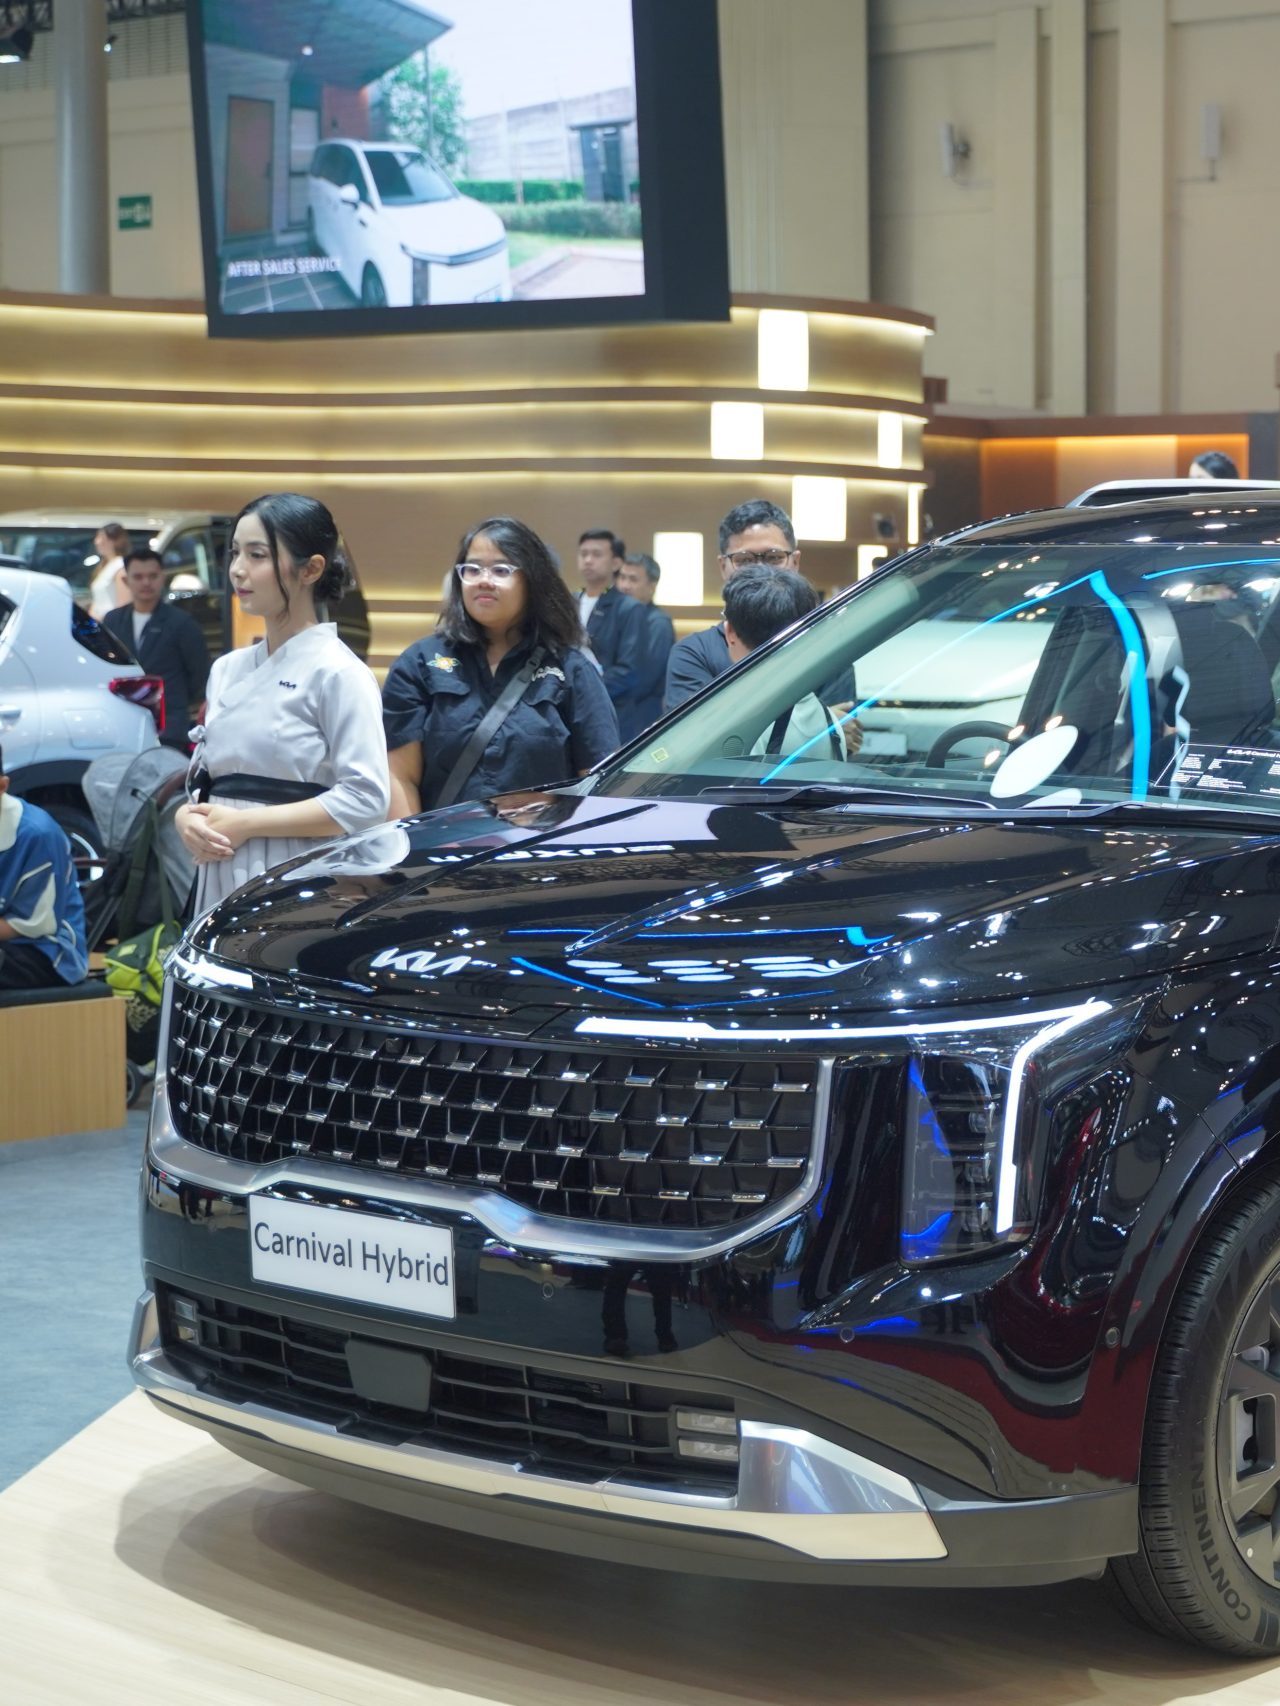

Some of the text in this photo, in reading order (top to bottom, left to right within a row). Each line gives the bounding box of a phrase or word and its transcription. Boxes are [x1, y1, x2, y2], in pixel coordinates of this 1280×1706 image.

[228, 260, 261, 277] AFTER
[262, 258, 295, 275] SALES
[370, 947, 472, 976] KIA
[254, 1222, 449, 1286] Carnival Hybrid
